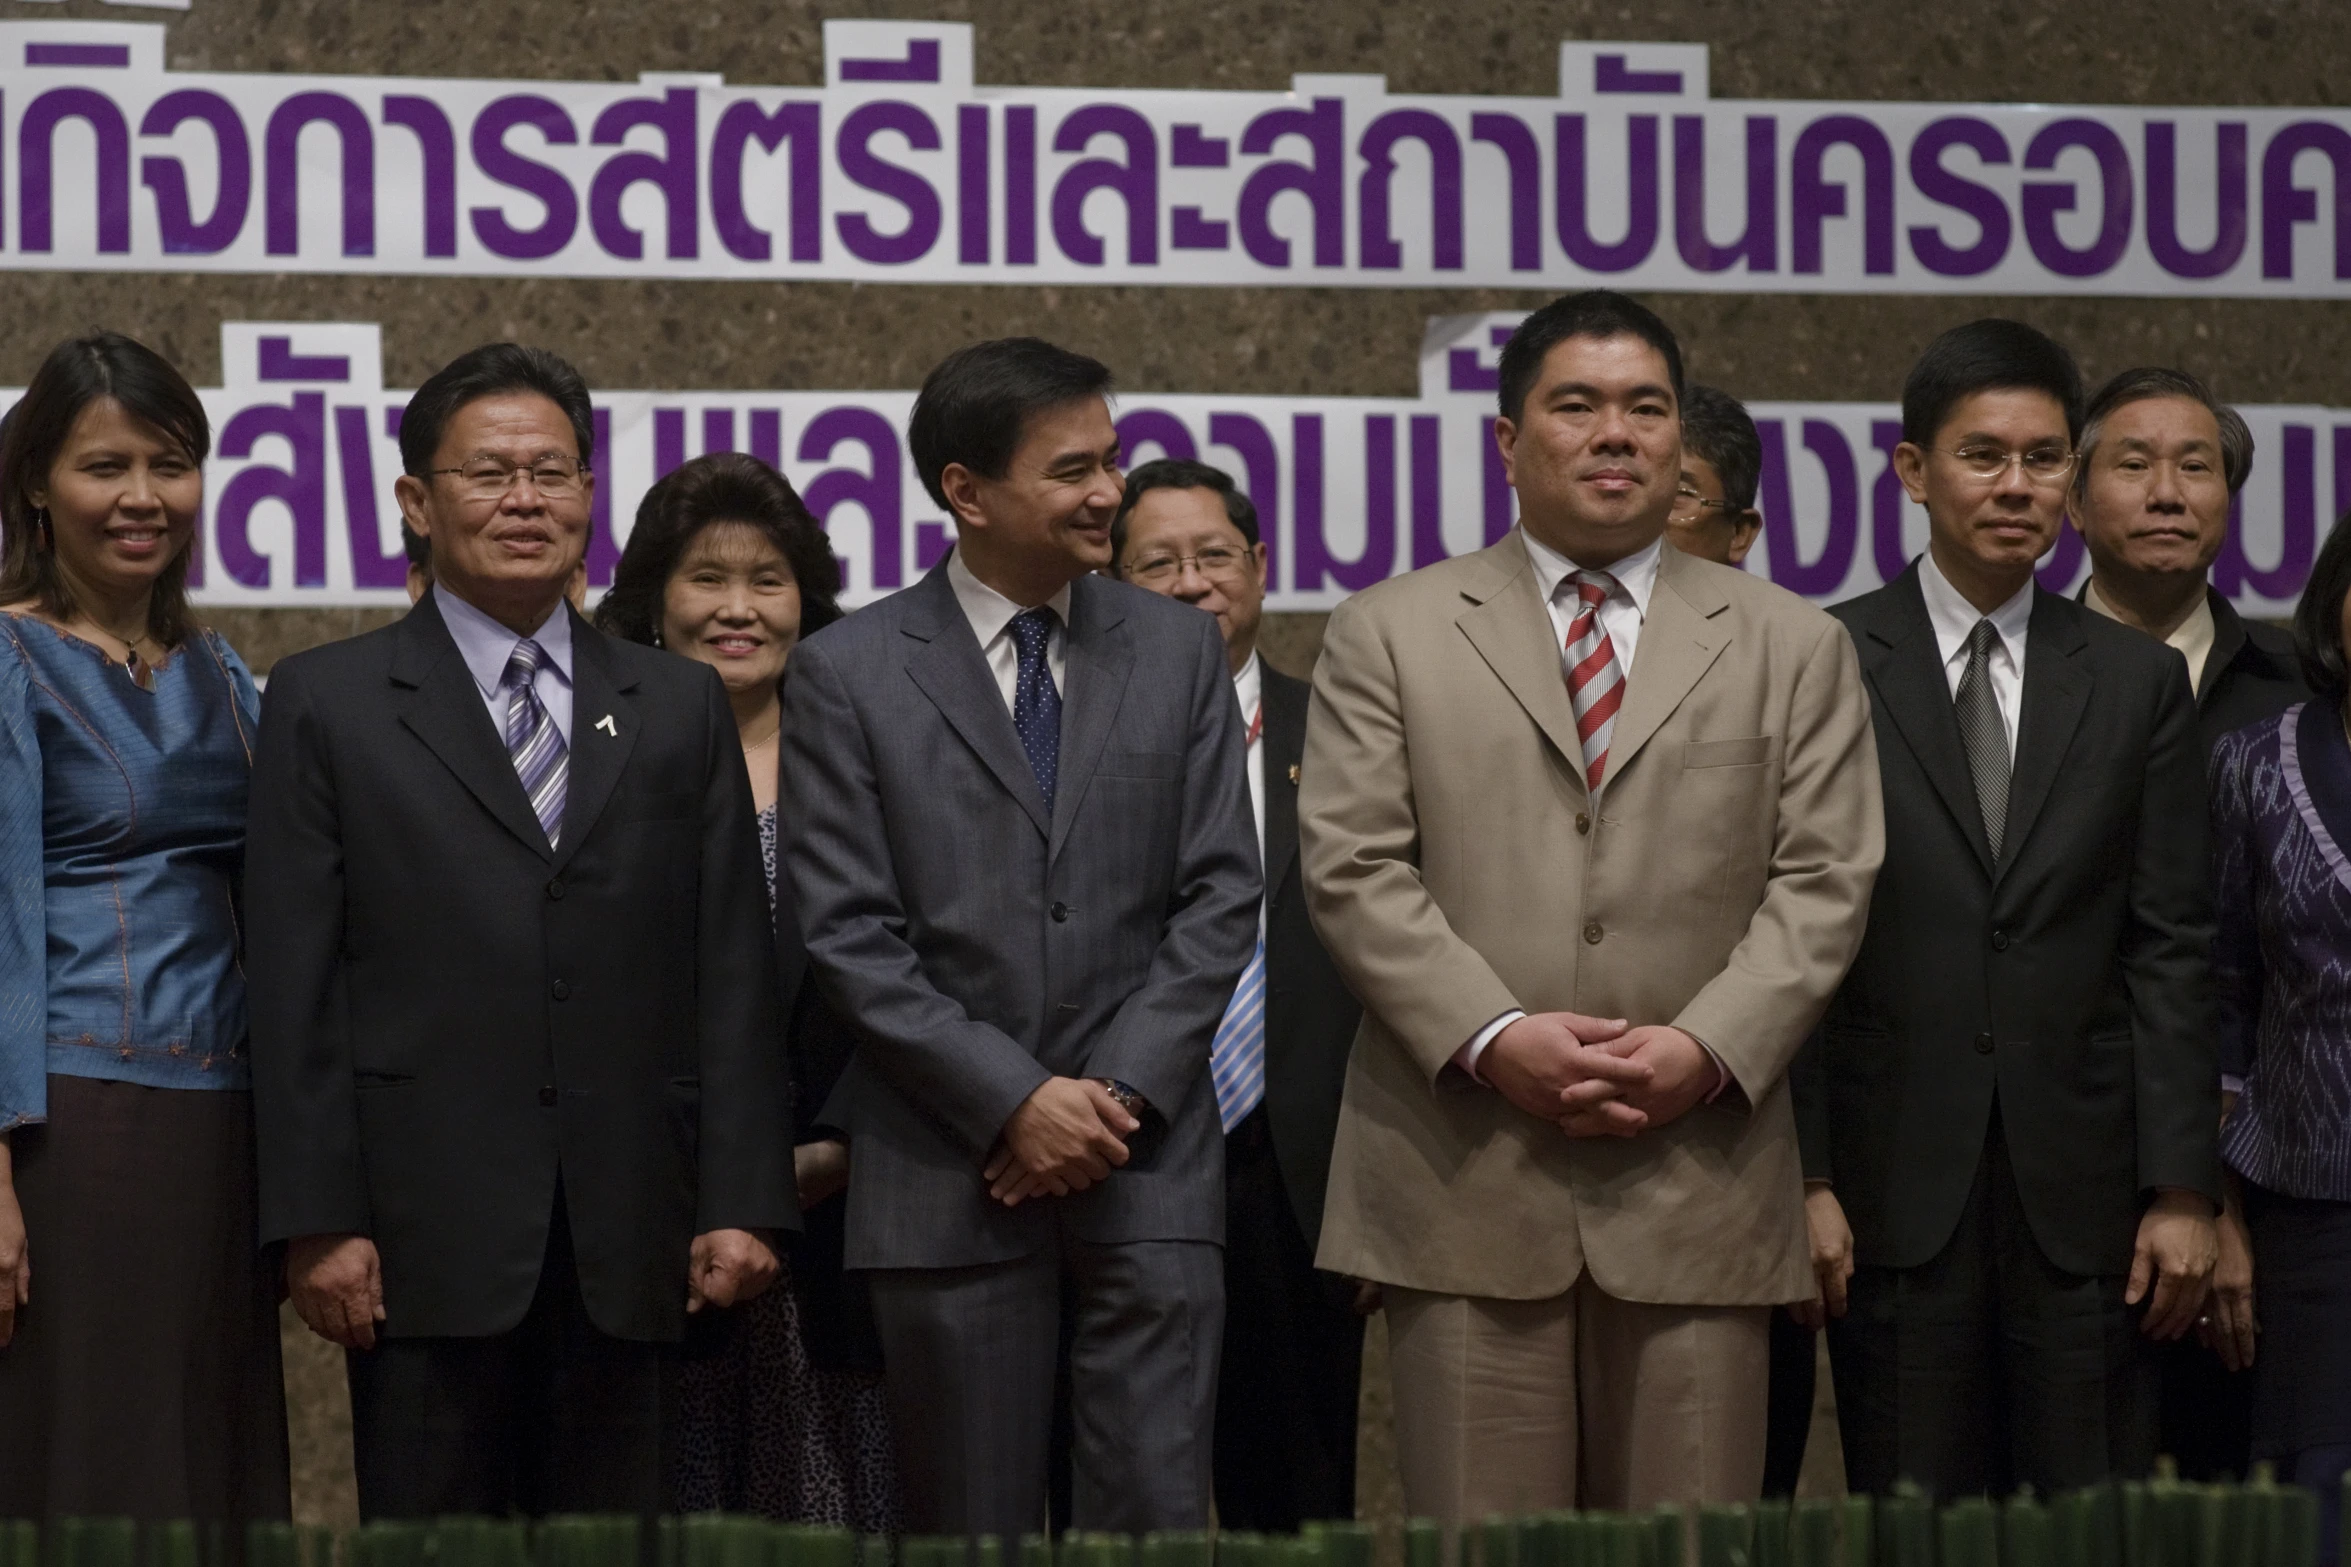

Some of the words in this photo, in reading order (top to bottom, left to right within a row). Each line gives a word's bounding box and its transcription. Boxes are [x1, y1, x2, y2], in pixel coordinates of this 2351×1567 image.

[0, 39, 2351, 279] กิจการสตรีและสถาบันครอบค
